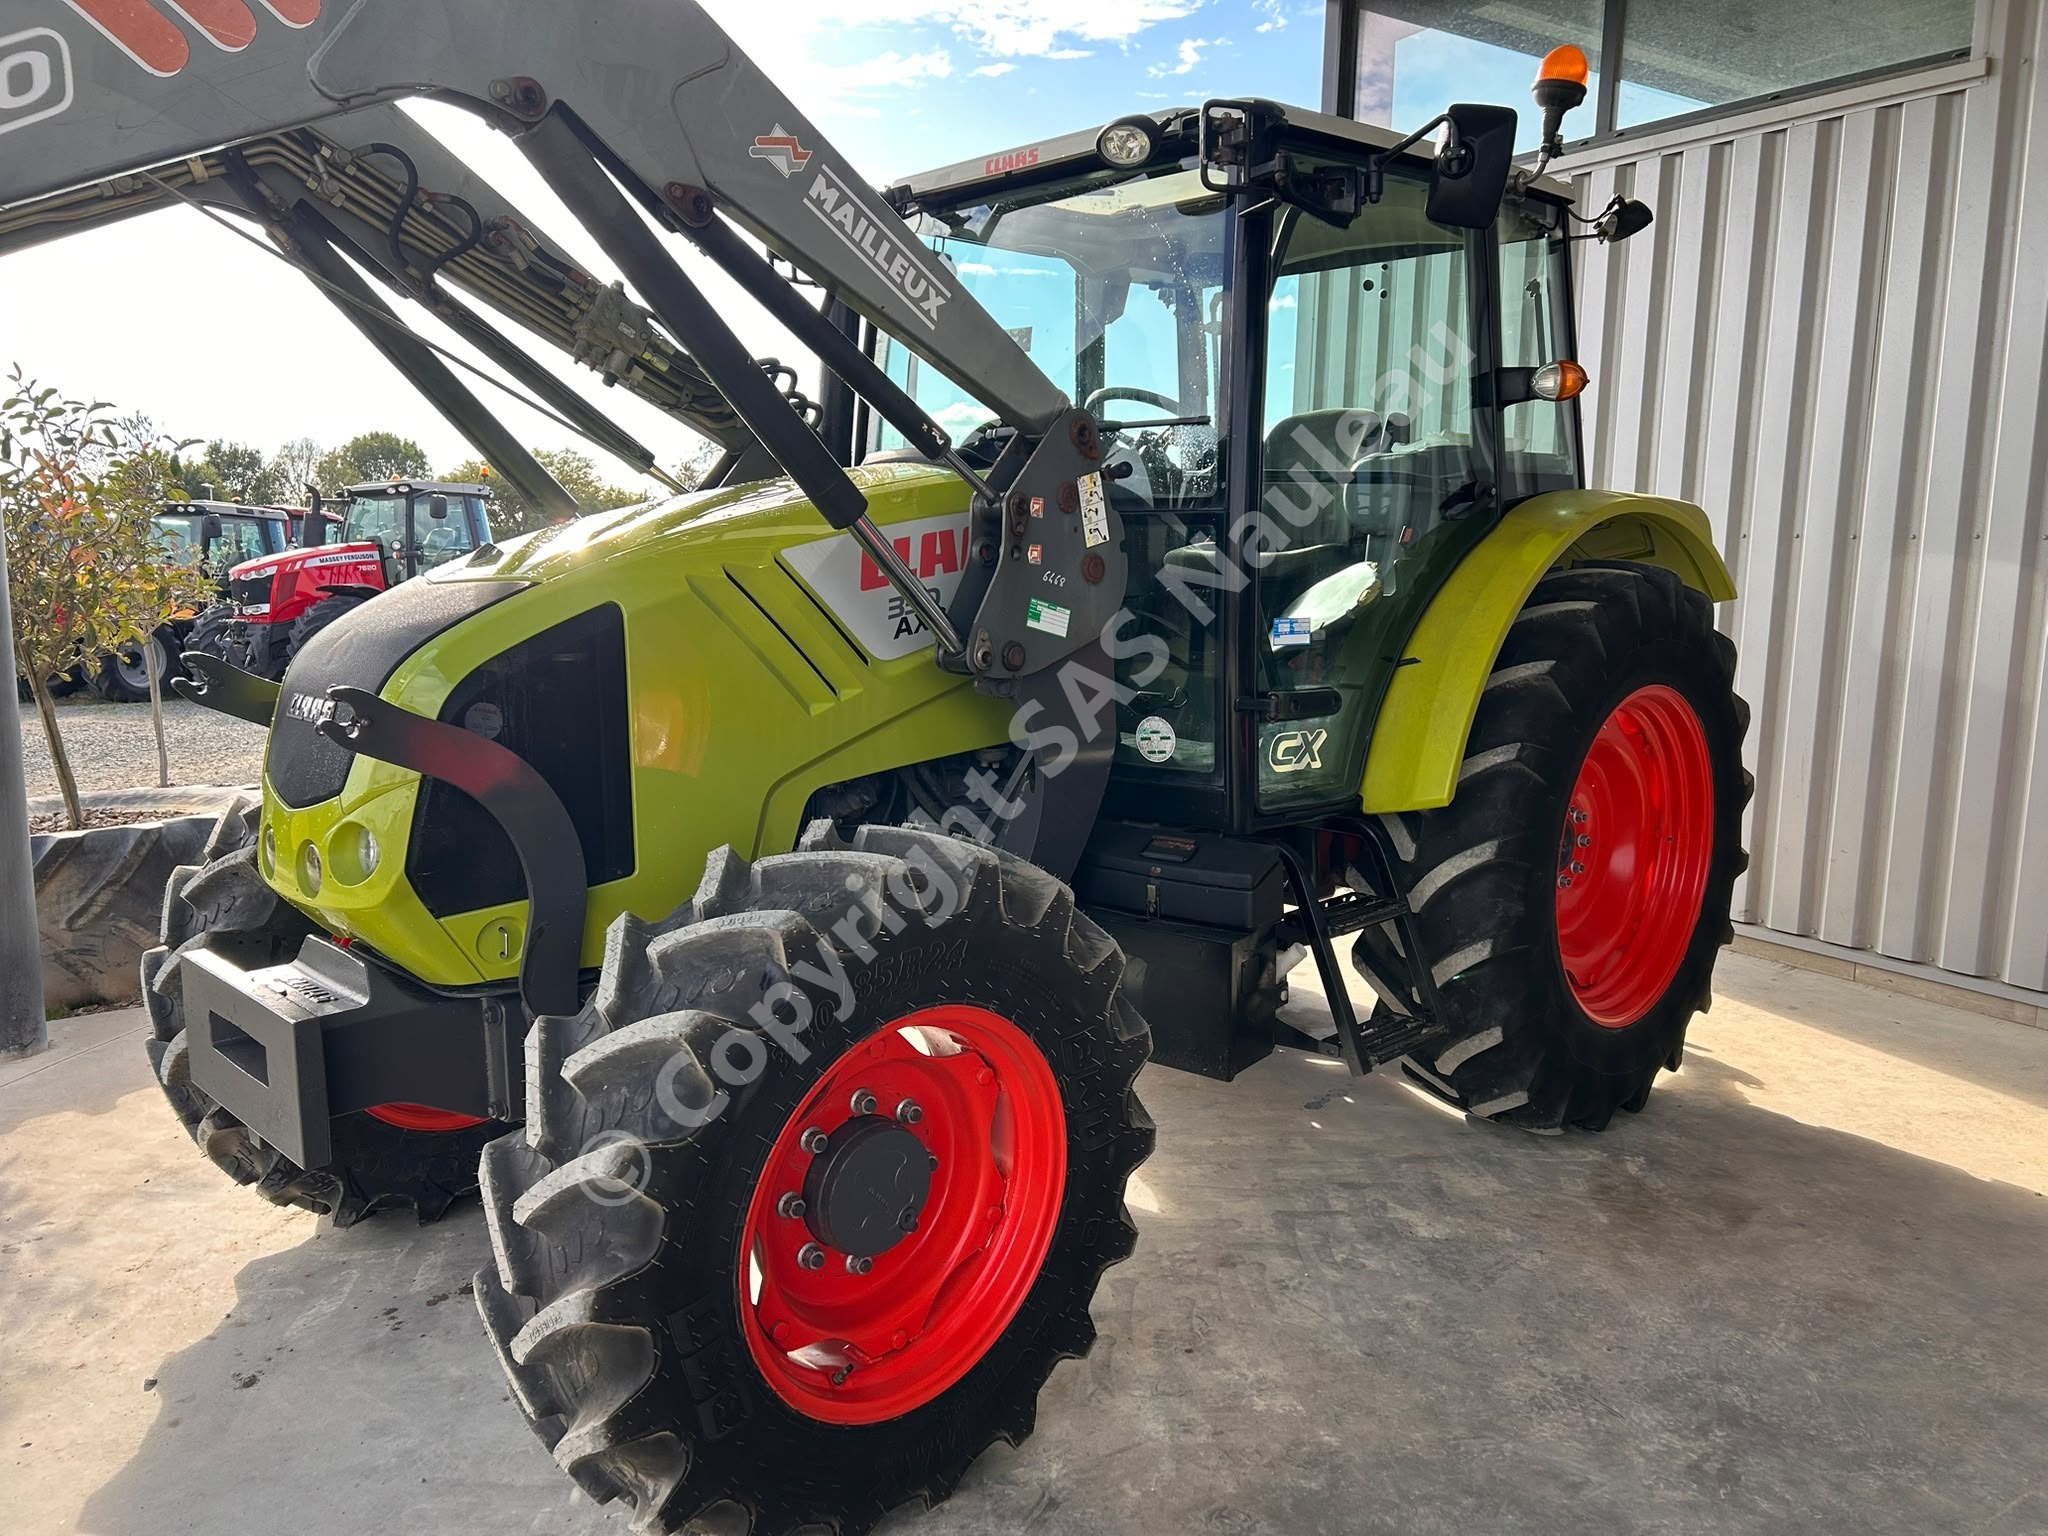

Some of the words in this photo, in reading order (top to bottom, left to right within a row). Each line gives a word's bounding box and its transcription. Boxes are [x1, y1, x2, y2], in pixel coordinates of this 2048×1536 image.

[985, 147, 1039, 175] CLAAS
[808, 173, 947, 322] MAILLEUX
[319, 555, 344, 564] MASSEY
[344, 553, 375, 561] FERGUSON
[1269, 729, 1328, 773] CX
